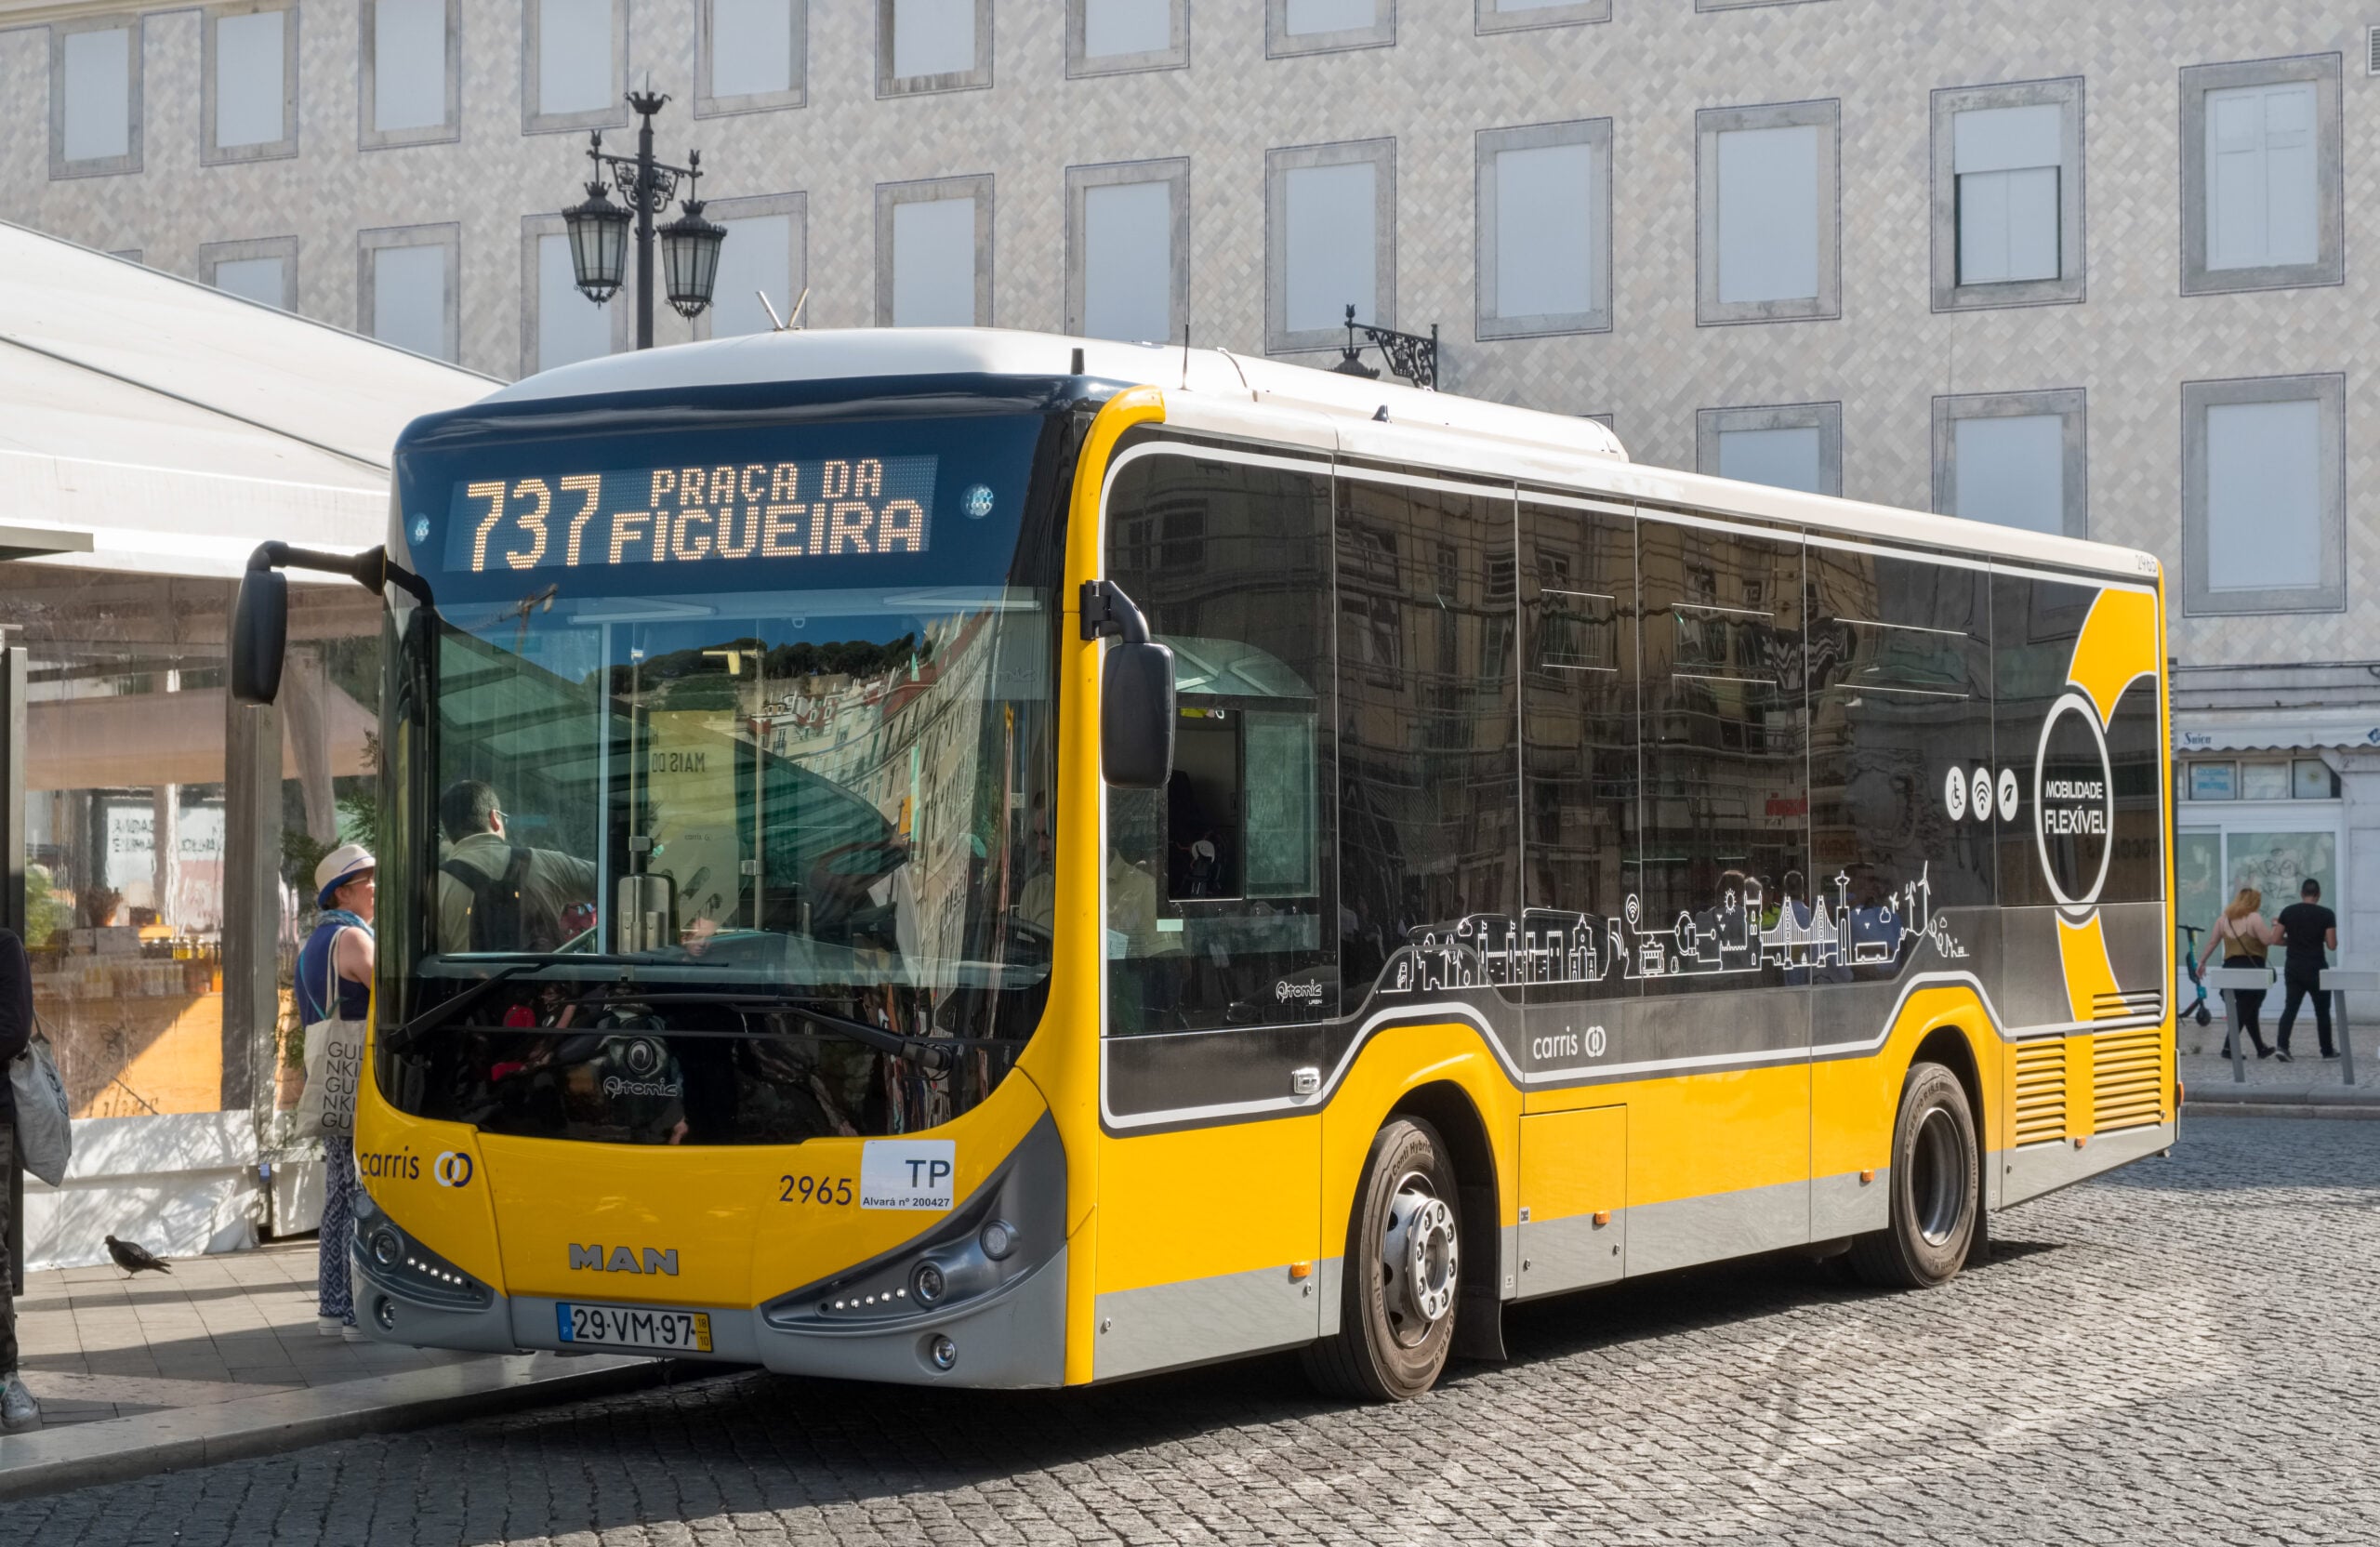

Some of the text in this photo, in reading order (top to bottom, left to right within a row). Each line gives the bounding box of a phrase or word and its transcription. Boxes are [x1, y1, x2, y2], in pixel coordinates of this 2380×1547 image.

[822, 458, 882, 498] DA
[468, 474, 601, 572] 737
[608, 498, 923, 565] FIGUEIRA
[2045, 781, 2103, 799] MOBILIDADE
[2045, 806, 2106, 834] FLEXÍVEL
[1533, 1025, 1578, 1060] carris
[360, 1145, 419, 1181] carris
[905, 1159, 951, 1189] TP
[1393, 1146, 1409, 1176] Conti
[779, 1174, 853, 1206] 2965
[863, 1197, 895, 1207] Alvará
[913, 1198, 950, 1207] 200427
[568, 1244, 679, 1276] MAN
[698, 1317, 707, 1328] 18
[700, 1337, 709, 1347] 10
